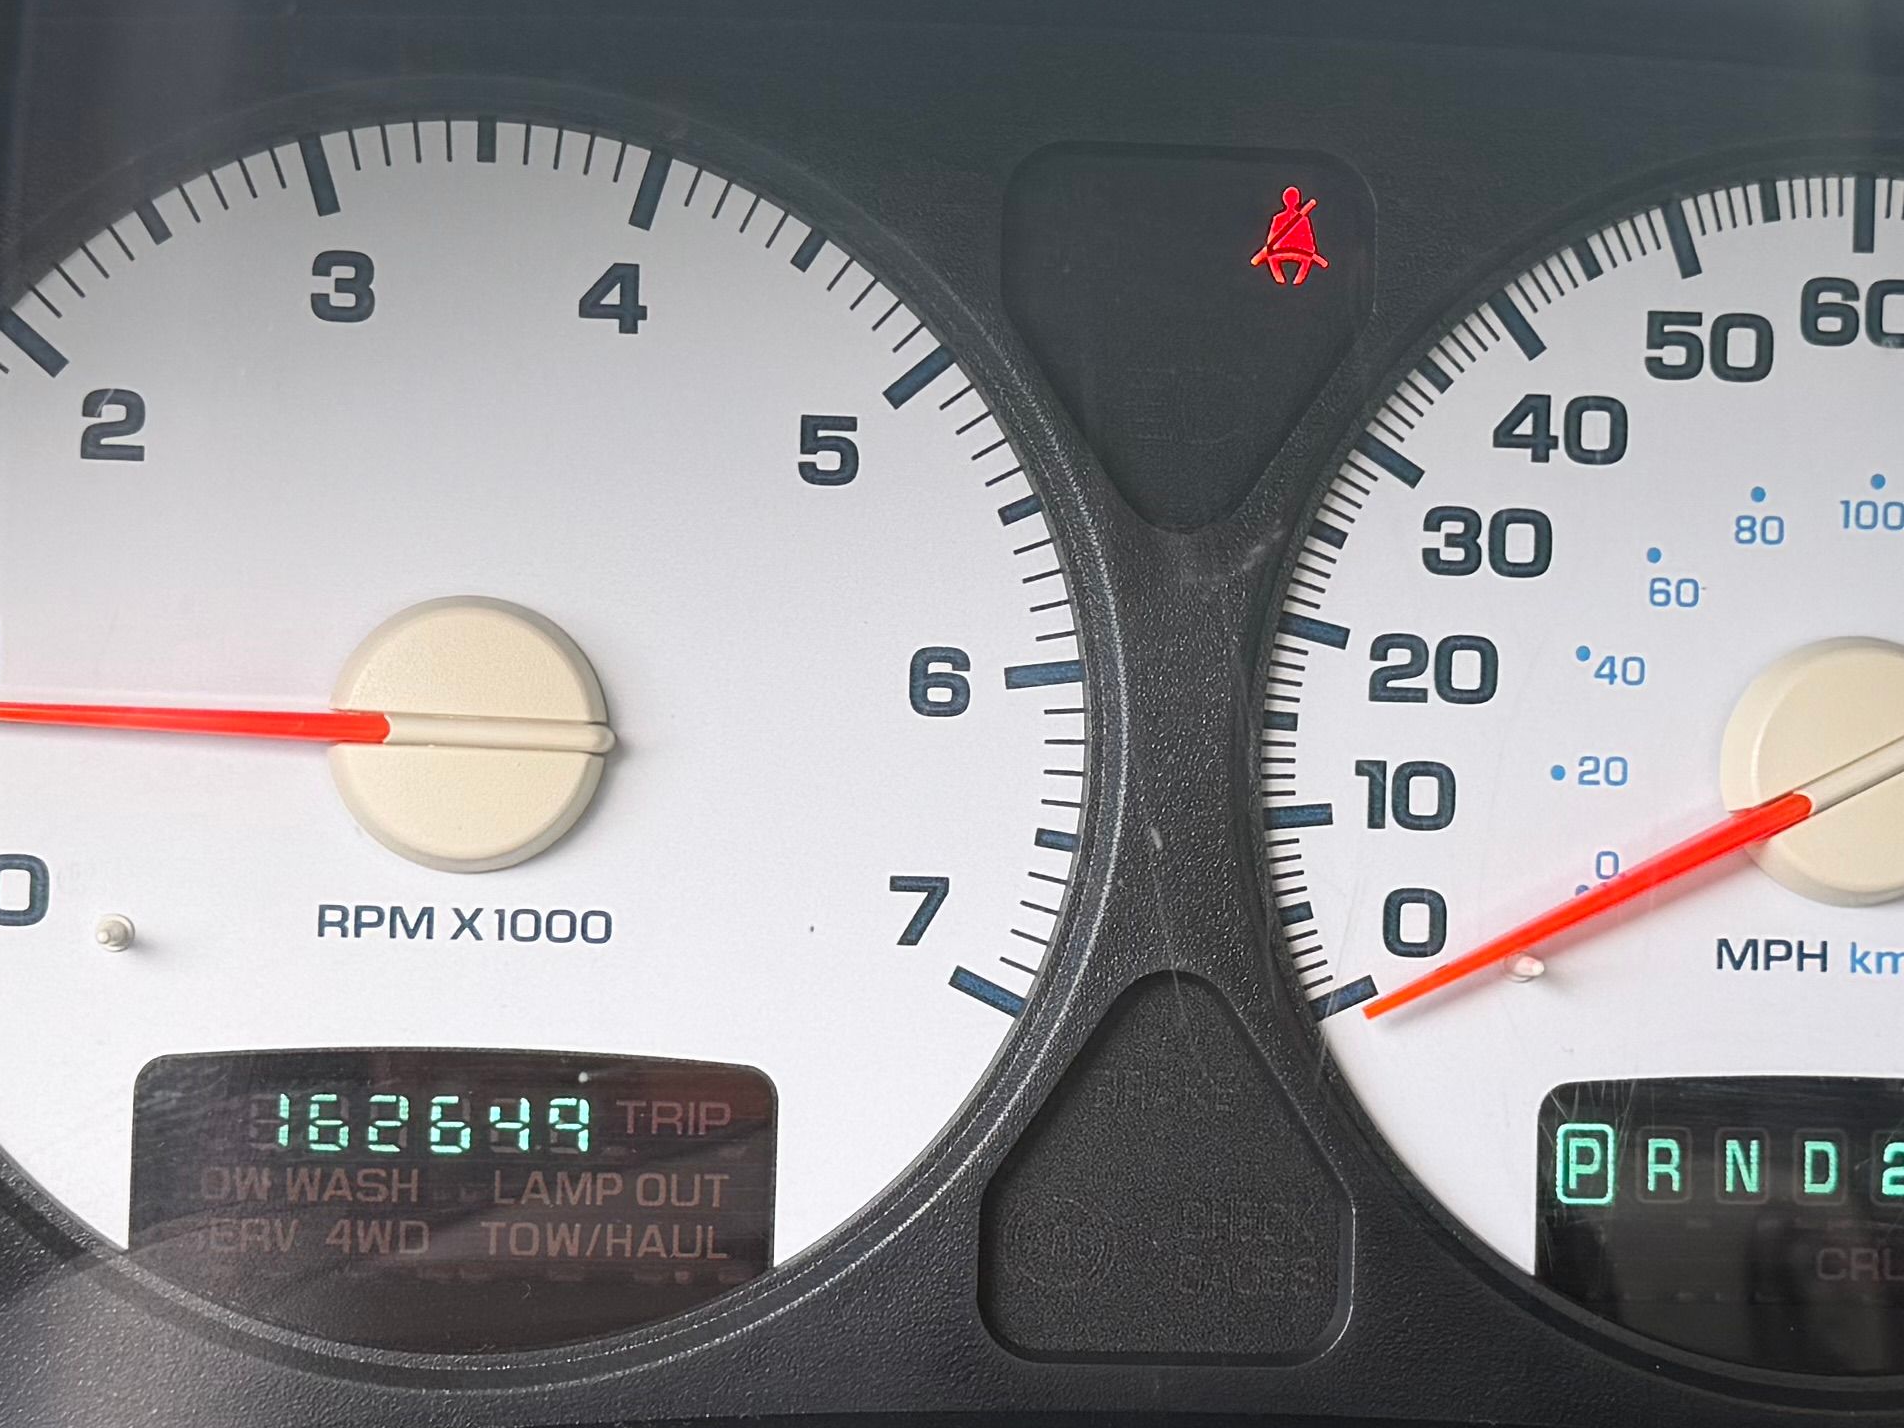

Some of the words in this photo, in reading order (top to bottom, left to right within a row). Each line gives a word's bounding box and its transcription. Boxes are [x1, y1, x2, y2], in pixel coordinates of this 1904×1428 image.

[311, 250, 375, 322] 3
[579, 263, 647, 334] 4
[1645, 311, 1774, 382] 50
[81, 389, 145, 461] 2
[798, 415, 859, 486] 5
[1493, 394, 1628, 465] 40
[1422, 506, 1552, 578] 30
[1735, 515, 1784, 545] 80
[1650, 578, 1699, 607] 60
[909, 647, 970, 717] 6
[1369, 633, 1498, 704] 20
[1594, 656, 1645, 685] 40
[1355, 760, 1456, 831] 10
[1578, 756, 1628, 786] 20
[1596, 851, 1619, 879] 0
[318, 905, 434, 939] RPM
[890, 876, 949, 946] 7
[1383, 888, 1447, 958] 0
[1717, 939, 1827, 972] MPH
[279, 1093, 590, 1153] 162649
[618, 1100, 732, 1135] TRIP
[286, 1167, 418, 1202] WASH
[495, 1170, 623, 1208] LAMP
[636, 1173, 730, 1209] OUT
[1568, 1137, 1601, 1190] P
[1647, 1138, 1681, 1191] R
[1725, 1139, 1760, 1193] N
[1803, 1141, 1838, 1194] D
[325, 1219, 429, 1254] 4WD
[481, 1222, 728, 1260] TOW/HAUL
